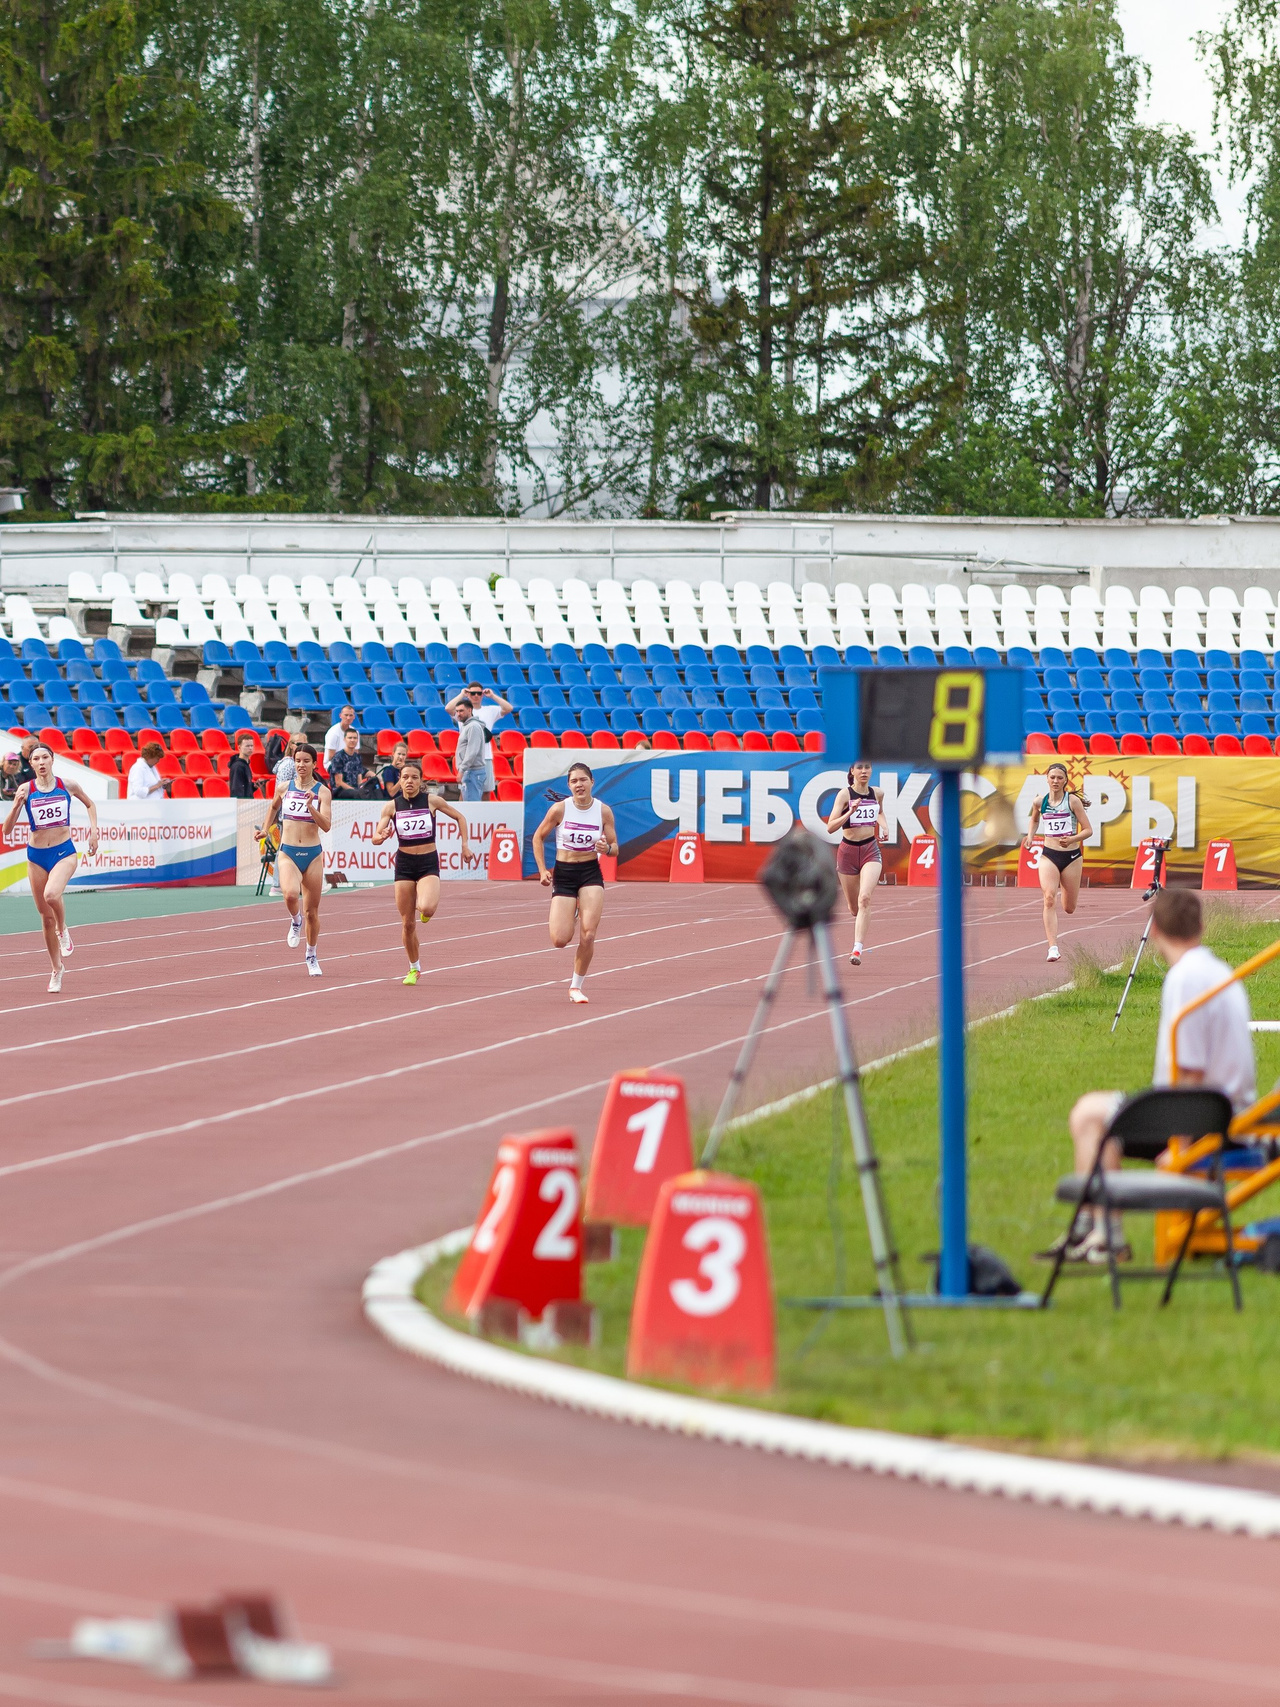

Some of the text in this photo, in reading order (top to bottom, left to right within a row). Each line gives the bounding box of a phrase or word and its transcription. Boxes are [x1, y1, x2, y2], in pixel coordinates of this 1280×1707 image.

[929, 671, 985, 761] 8
[38, 806, 62, 820] 285
[855, 808, 875, 819] 213
[130, 825, 212, 842] ПОДГОТОВКИ
[403, 820, 426, 831] 372
[1048, 821, 1066, 831] 157
[497, 839, 514, 863] 8
[569, 833, 592, 846] 159
[95, 853, 155, 867] Игнатьева
[679, 841, 696, 865] 6
[916, 844, 935, 869] 4
[1026, 845, 1043, 870] 3
[1141, 848, 1156, 870] 2
[1214, 847, 1228, 871] 1
[626, 1099, 670, 1174] 1
[532, 1168, 578, 1260] 2
[669, 1217, 747, 1317] 3
